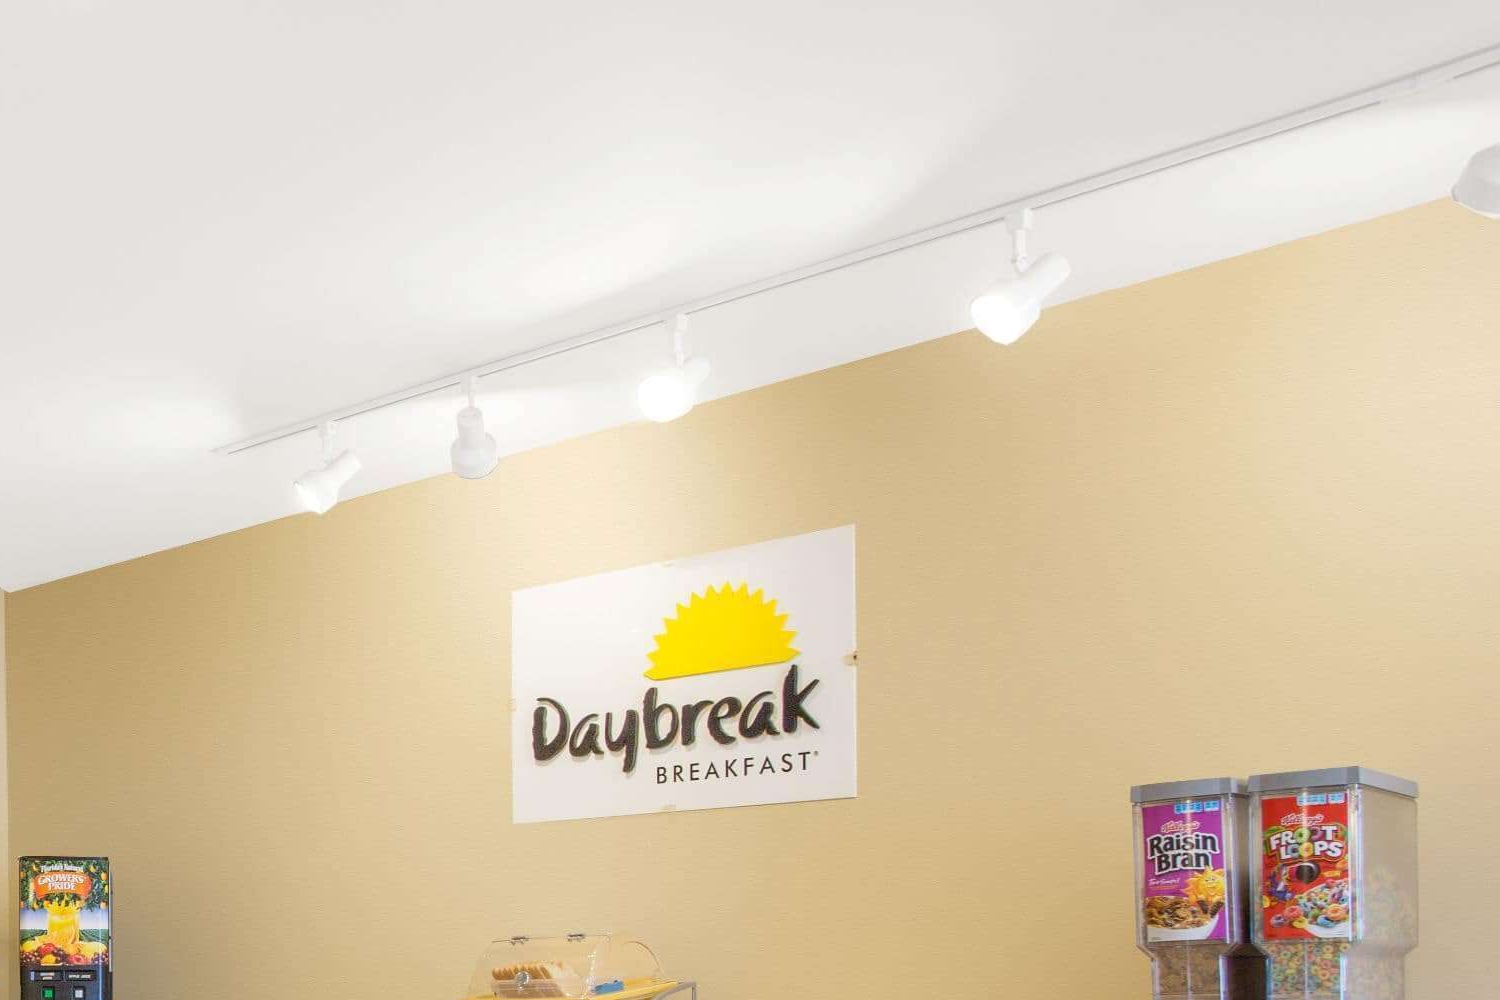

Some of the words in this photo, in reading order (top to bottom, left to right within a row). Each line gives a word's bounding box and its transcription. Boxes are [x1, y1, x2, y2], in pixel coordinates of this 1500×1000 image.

[532, 664, 820, 773] Daybreak
[656, 751, 811, 784] BREAKFAST
[1147, 832, 1220, 858] Raisin
[1269, 825, 1338, 850] FROOT
[1279, 840, 1343, 860] LOOPS
[1156, 851, 1213, 875] Bran
[48, 881, 77, 891] PRIDE
